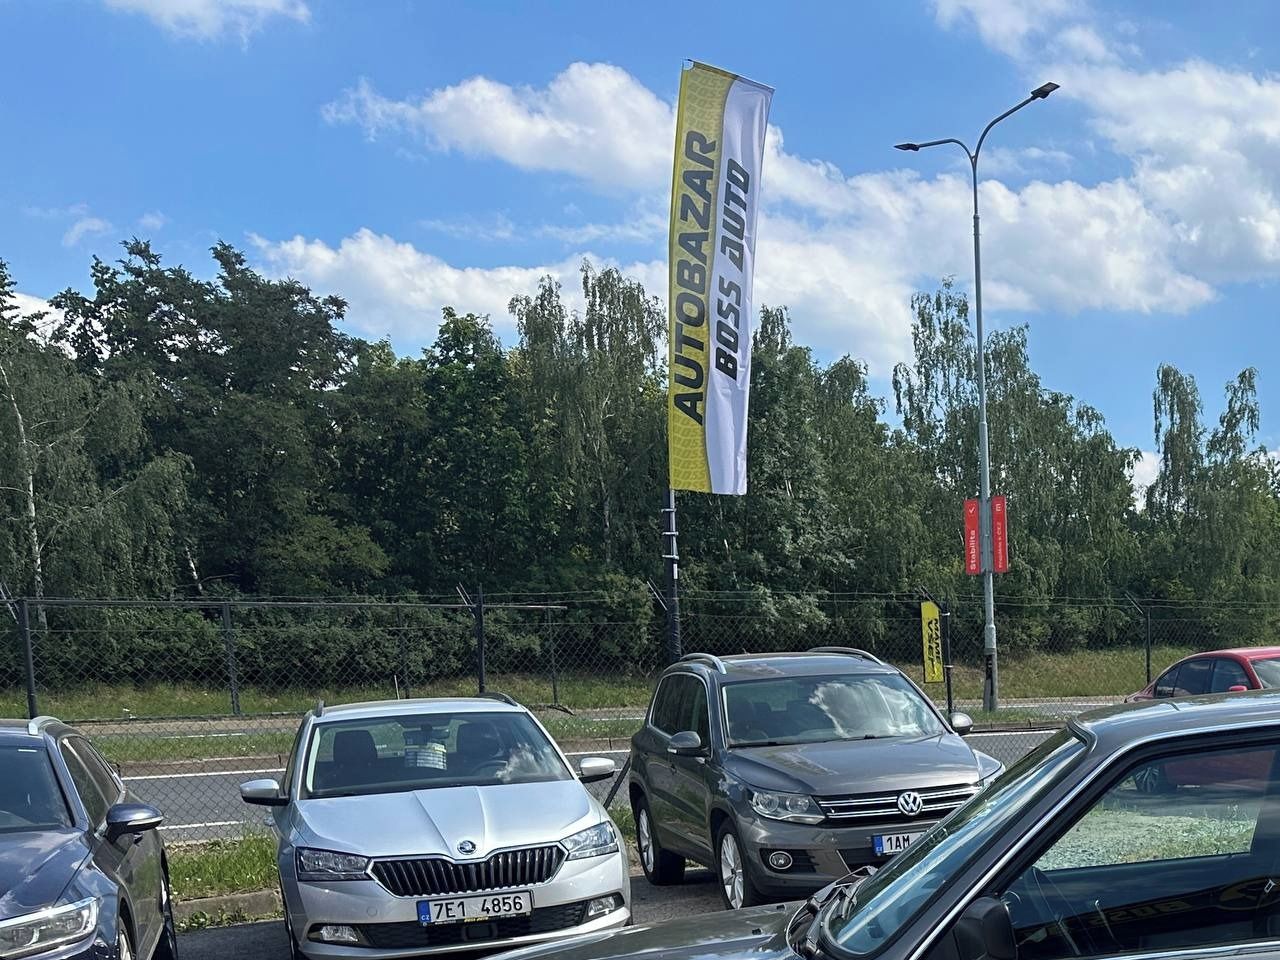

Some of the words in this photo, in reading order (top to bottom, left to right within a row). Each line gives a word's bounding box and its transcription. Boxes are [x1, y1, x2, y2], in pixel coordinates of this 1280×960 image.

[720, 157, 750, 274] AUTO
[673, 130, 717, 427] AUTOBAZAR
[715, 275, 742, 382] BOSS
[969, 529, 977, 571] Stabilita
[433, 900, 466, 920] 7E1
[481, 895, 523, 915] 4856
